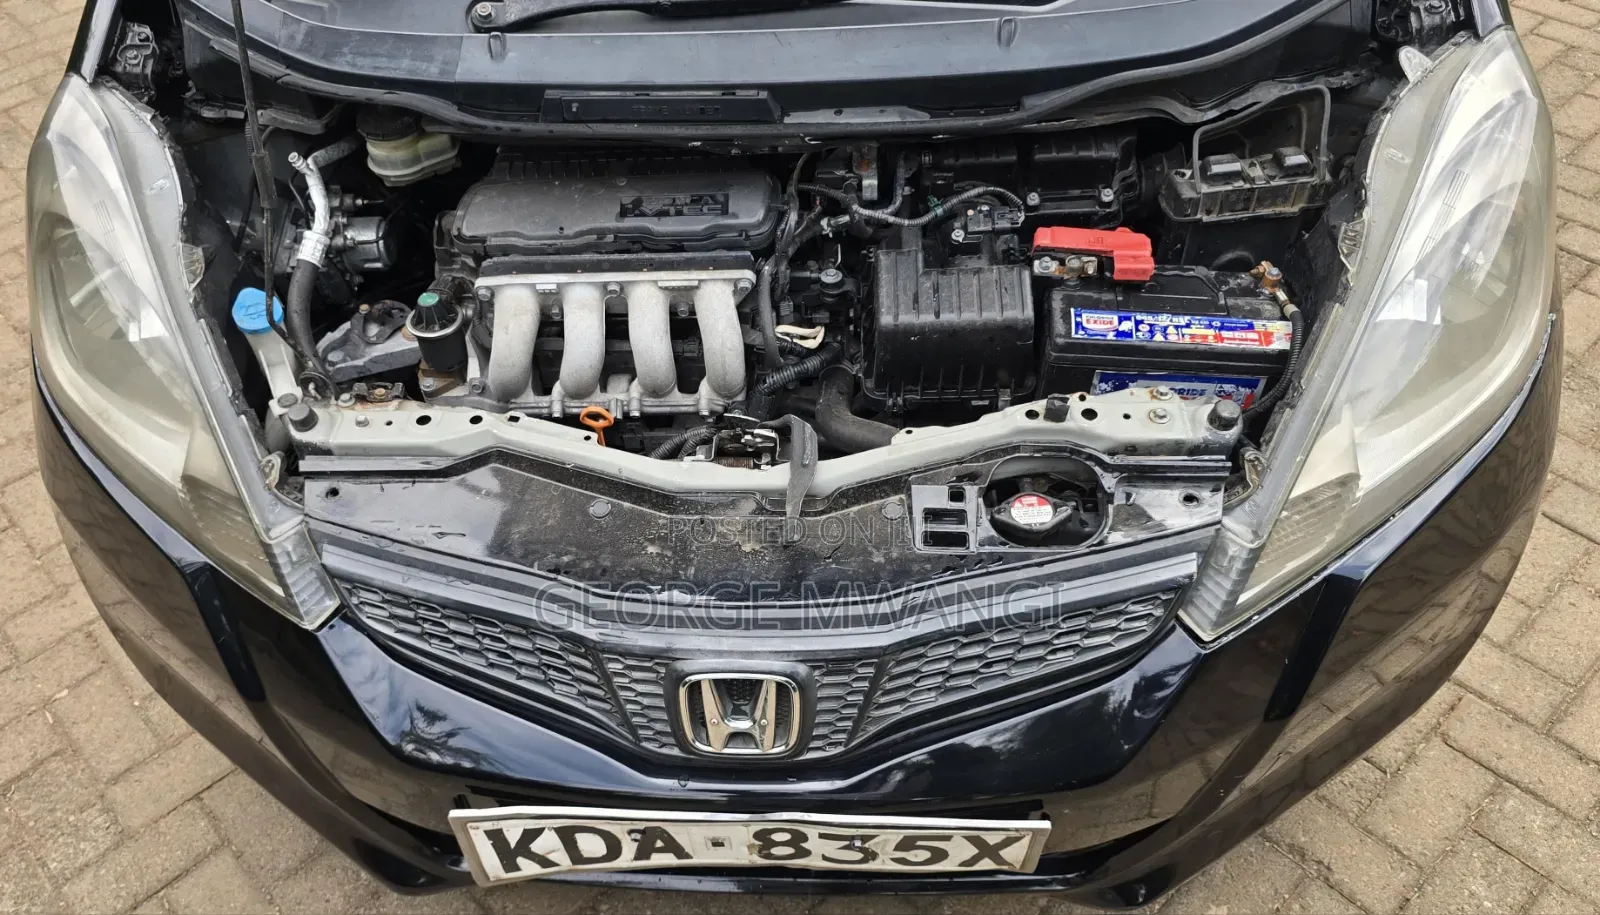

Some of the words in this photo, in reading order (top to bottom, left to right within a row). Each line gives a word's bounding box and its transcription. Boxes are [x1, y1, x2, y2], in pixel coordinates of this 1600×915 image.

[1085, 318, 1115, 326] EXIDE
[1169, 387, 1207, 397] ORIDE
[483, 825, 693, 873] KDA
[753, 827, 1024, 869] 835X
